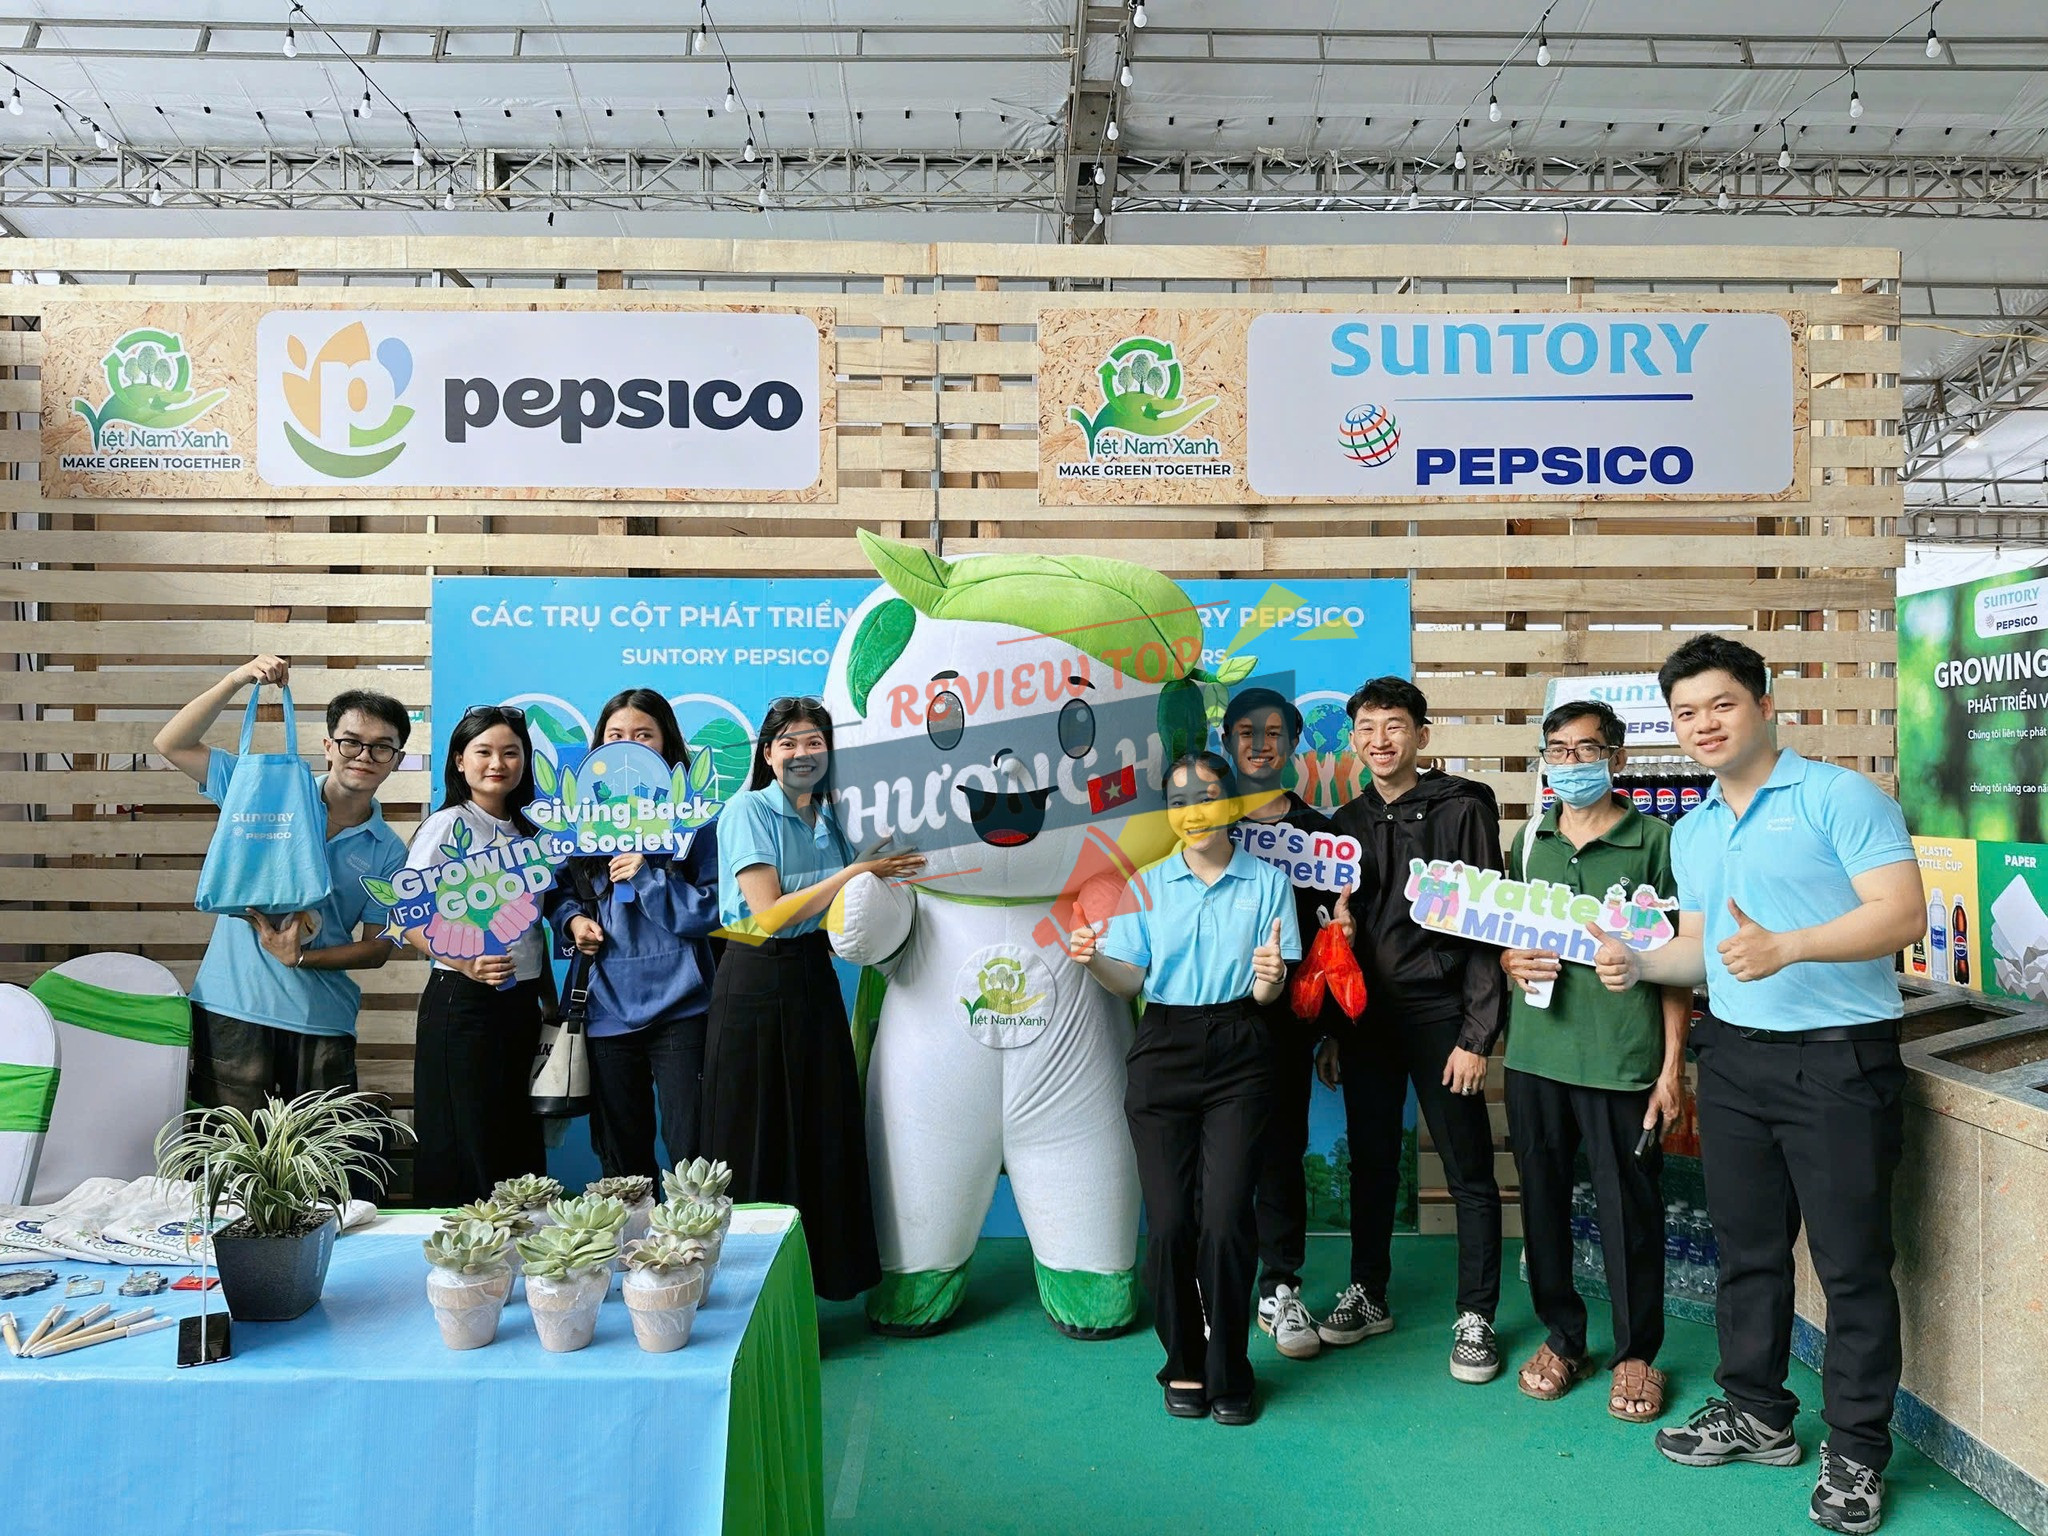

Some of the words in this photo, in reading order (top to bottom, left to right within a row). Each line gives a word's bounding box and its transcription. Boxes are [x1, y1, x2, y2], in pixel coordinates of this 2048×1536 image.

[1330, 322, 1709, 376] SUNTORY
[445, 376, 803, 443] pepsico
[131, 430, 176, 447] Nam
[181, 430, 229, 447] Xanh
[1124, 438, 1167, 454] Nam
[1172, 438, 1219, 454] Xanh
[62, 457, 105, 468] MAKE
[109, 457, 159, 468] GREEN
[163, 457, 241, 468] TOGETHER
[1059, 465, 1100, 476] MAKE
[1104, 465, 1151, 475] GREEN
[1155, 464, 1231, 475] TOGETHER
[1416, 446, 1694, 486] PEPSICO
[1983, 587, 2040, 609] SUNTORY
[471, 600, 533, 627] CÁC
[541, 605, 601, 632] TRỤ
[610, 601, 672, 632] CỘT
[680, 601, 761, 627] PHÁT
[767, 598, 854, 628] TRIỂN
[1239, 606, 1365, 628] PEPSICO
[1996, 615, 2038, 631] PEPSICO
[622, 648, 728, 665] SUNTORY
[734, 648, 830, 665] PEPSICO
[1934, 648, 2048, 690] GROWING
[1967, 694, 1999, 714] PHÁT
[1999, 688, 2037, 711] TRIỂN
[1967, 729, 1991, 741] Chúng
[1991, 729, 2002, 739] tôi
[2002, 728, 2016, 738] liên
[2029, 726, 2048, 739] phát
[1970, 782, 1991, 795] chúng
[1992, 782, 2002, 792] tôi
[2003, 783, 2022, 796] nâng
[2022, 784, 2037, 793] cao
[231, 812, 295, 823] SUNTORY
[530, 797, 632, 829] Giving
[637, 796, 713, 822] Back
[246, 831, 292, 840] PEPSICO
[551, 835, 575, 854] to
[579, 829, 694, 859] Society
[1313, 837, 1355, 861] no
[1919, 846, 1953, 858] PLASTIC
[391, 831, 567, 900] Growing
[1256, 855, 1327, 884] net
[1334, 862, 1355, 887] B
[1917, 859, 1944, 871] OTTLE,
[1945, 860, 1963, 872] CUP
[2004, 854, 2037, 869] PAPER
[436, 864, 552, 920] GOOD
[1463, 868, 1600, 925] Yatte
[396, 901, 431, 924] For
[990, 1015, 1016, 1026] Nam
[1019, 1016, 1046, 1026] Xanh
